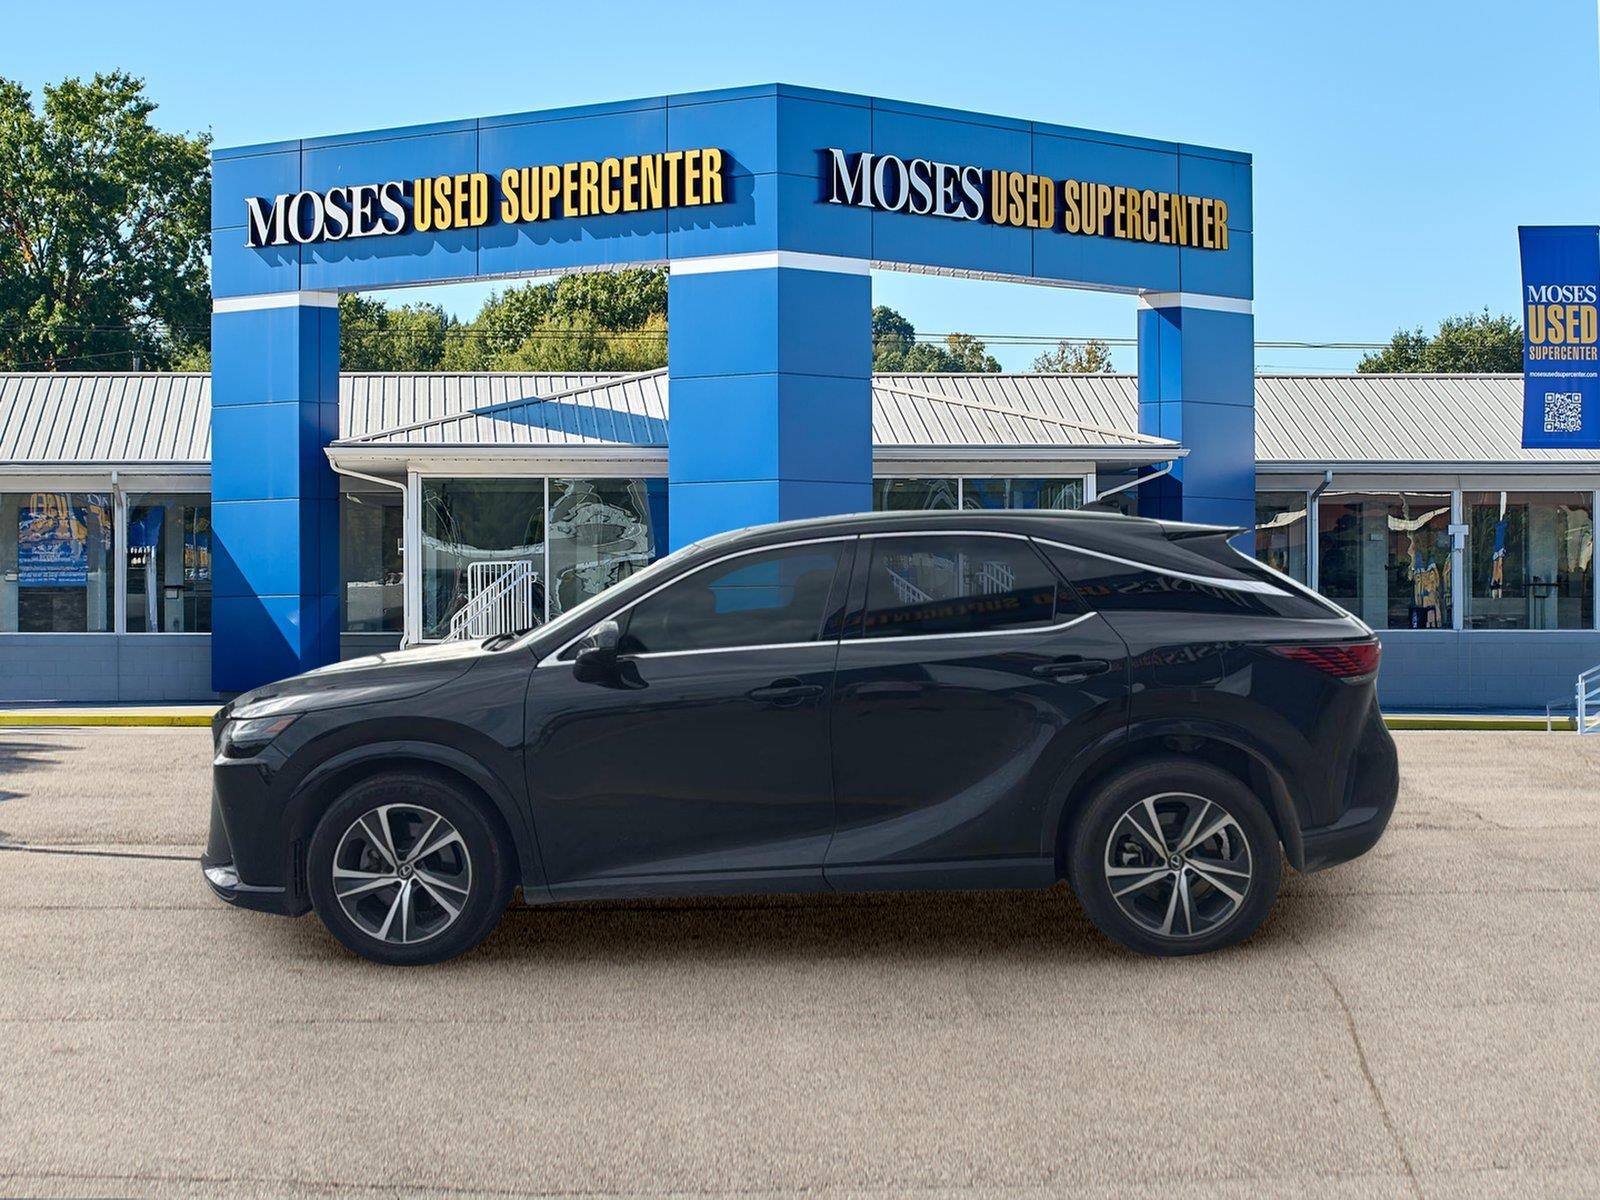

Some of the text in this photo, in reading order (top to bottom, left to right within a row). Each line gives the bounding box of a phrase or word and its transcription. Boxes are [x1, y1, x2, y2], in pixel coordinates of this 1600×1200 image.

[245, 147, 723, 248] MOSES USED SUPERCENTER
[829, 148, 1229, 250] MOSES USED SUPERCENTER
[1527, 285, 1597, 303] MOSES
[1528, 304, 1597, 344] USED
[1529, 346, 1598, 360] SUPERCENTER
